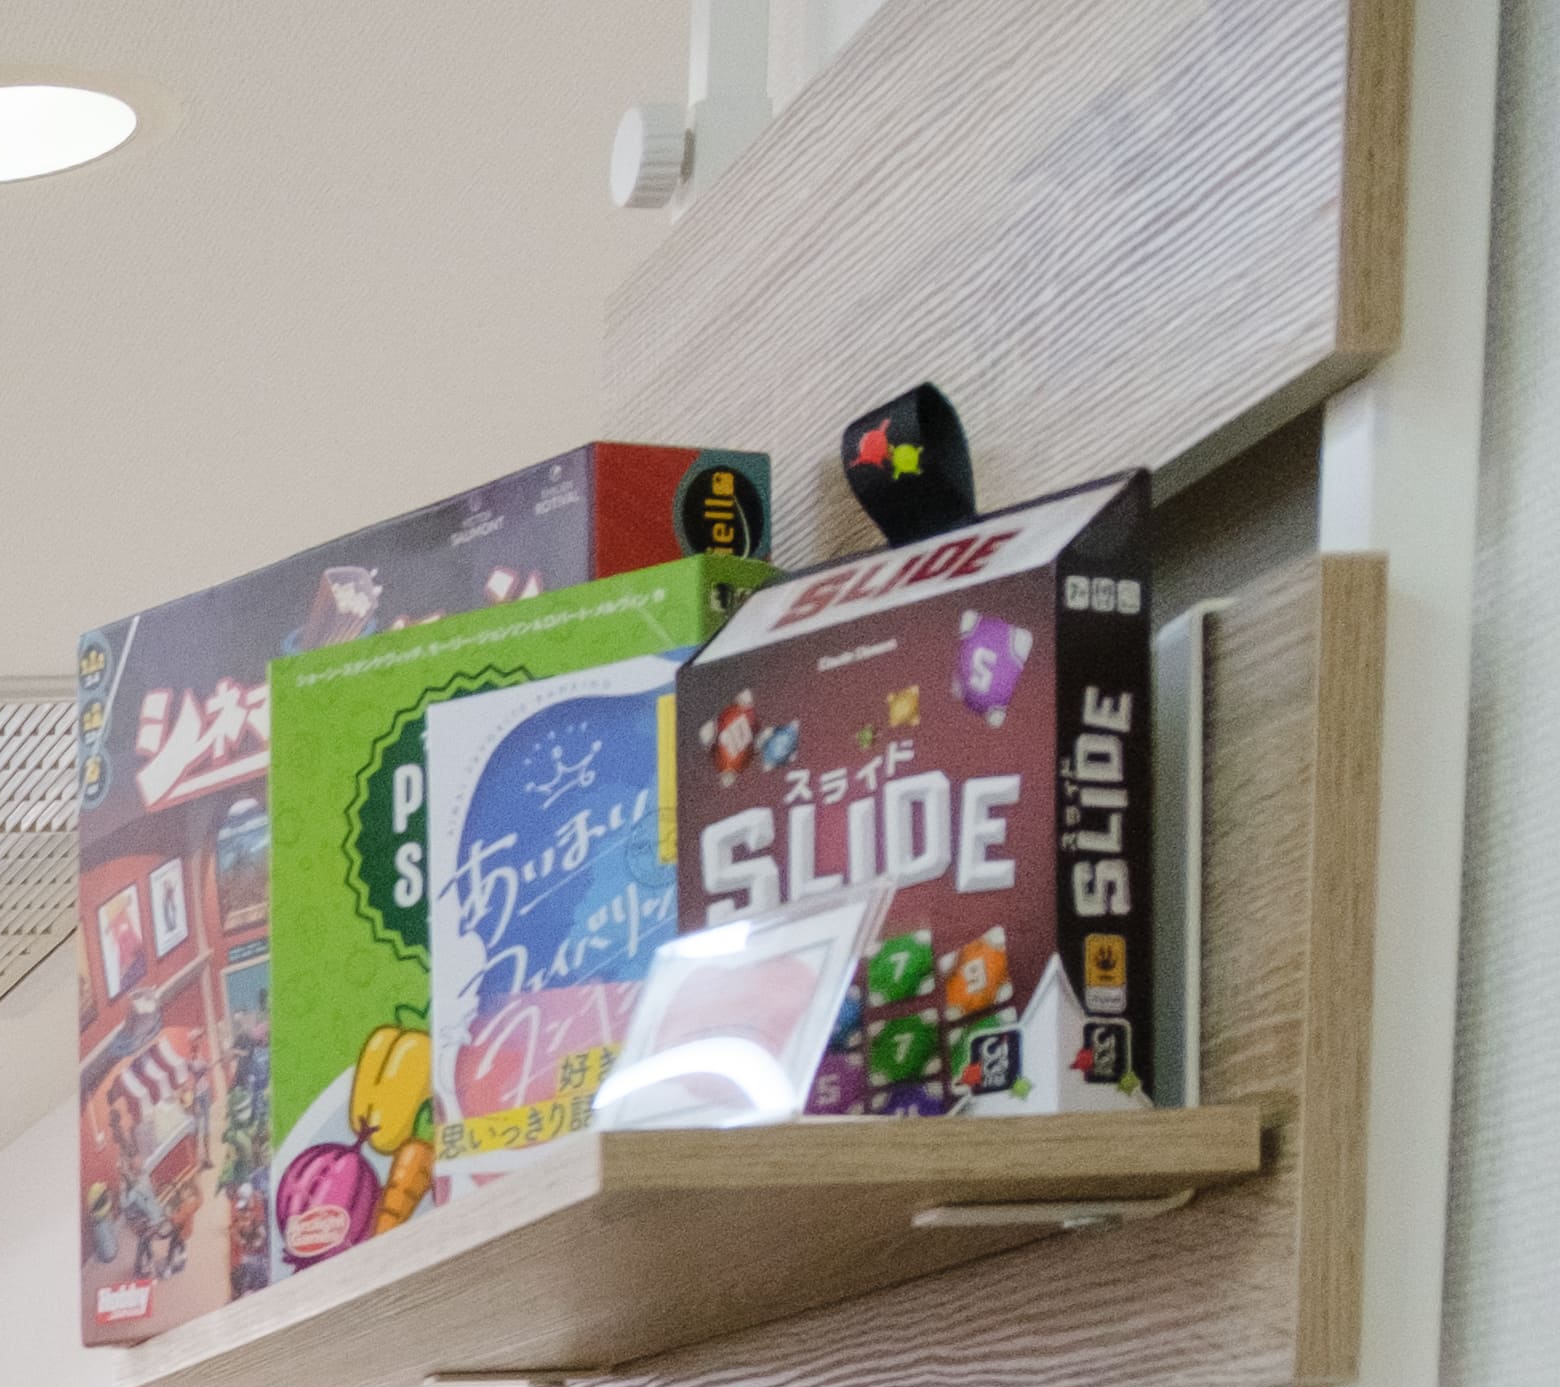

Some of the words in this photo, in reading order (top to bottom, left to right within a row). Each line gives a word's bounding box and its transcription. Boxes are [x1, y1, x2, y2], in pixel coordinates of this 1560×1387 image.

[769, 528, 1023, 631] SLIDE
[783, 739, 916, 805] スライド
[1073, 686, 1133, 917] SLIDE
[701, 769, 1022, 928] SLIDE
